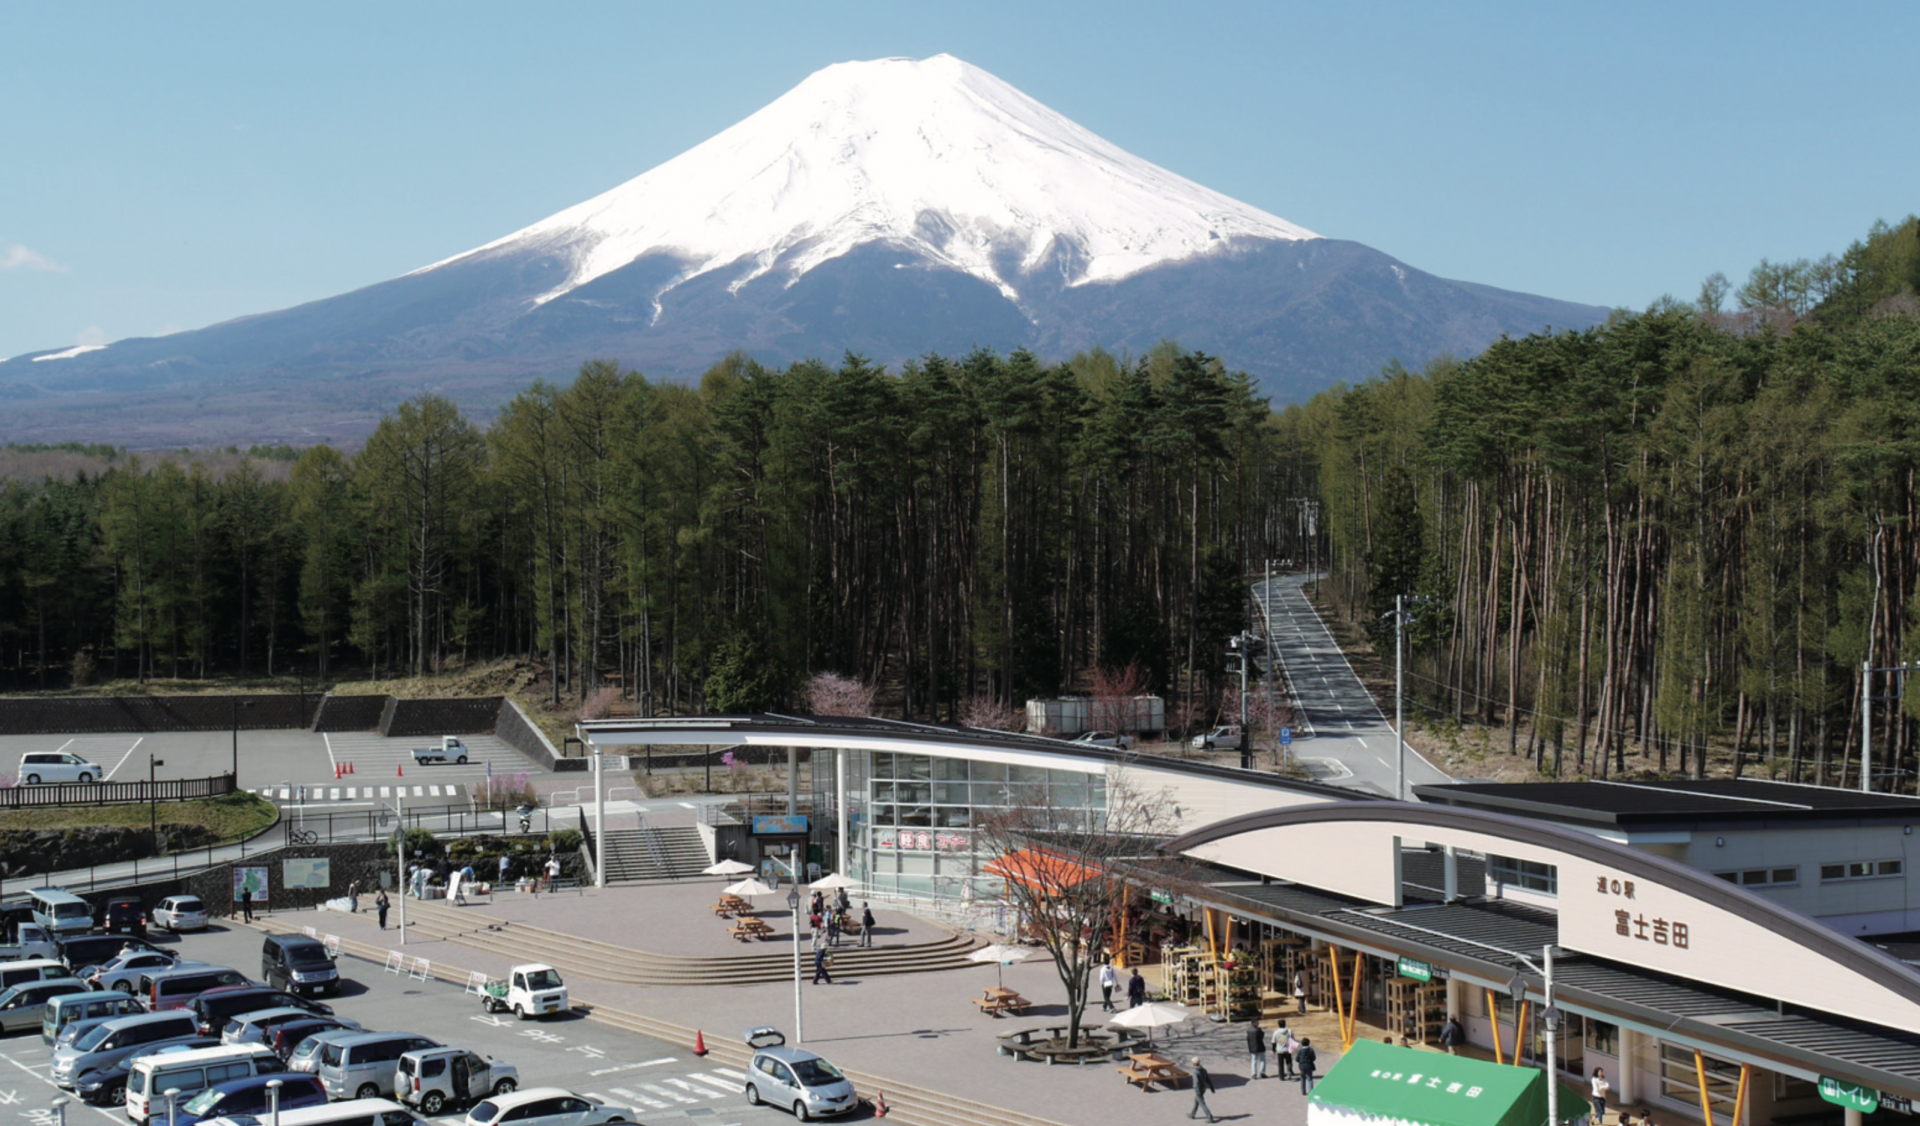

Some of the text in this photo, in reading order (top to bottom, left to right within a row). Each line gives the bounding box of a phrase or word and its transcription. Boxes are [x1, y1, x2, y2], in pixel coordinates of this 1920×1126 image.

[1597, 876, 1635, 899] 道の駅
[1615, 909, 1688, 949] 富士吉田
[1836, 1081, 1871, 1106] トイレ
